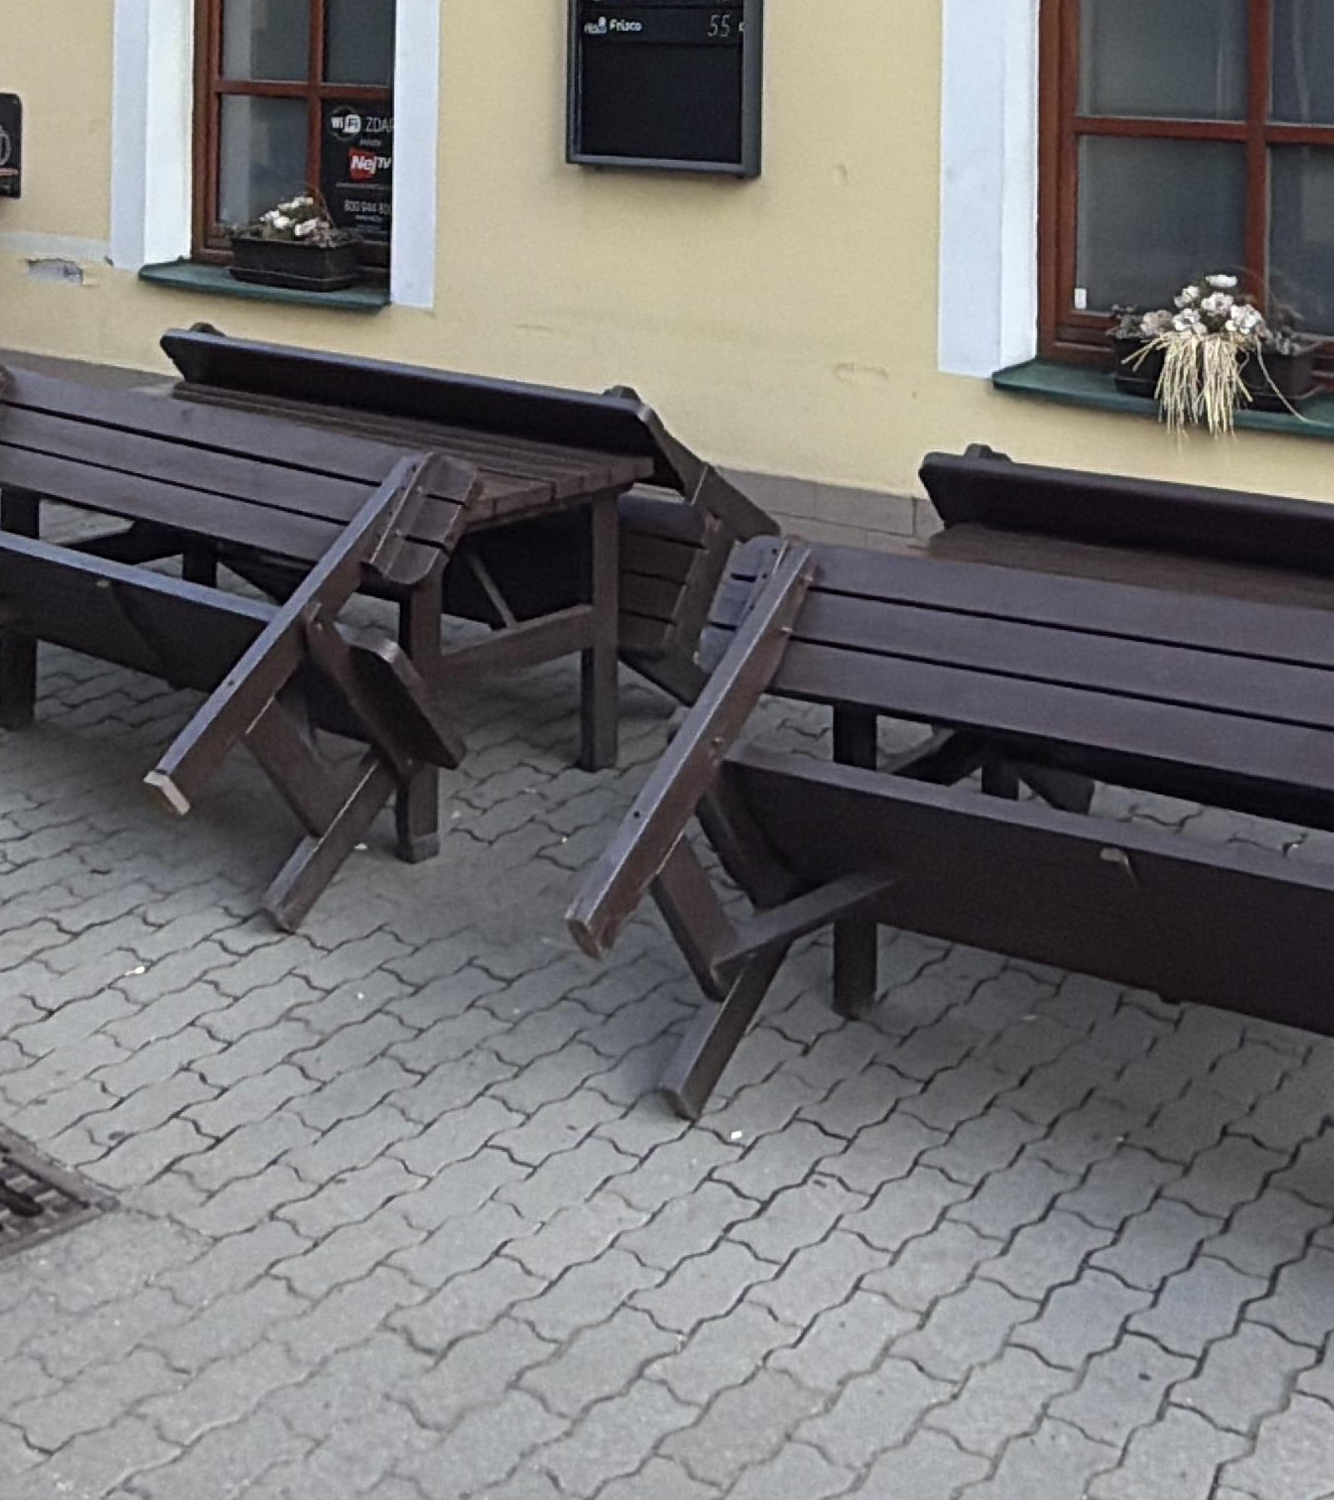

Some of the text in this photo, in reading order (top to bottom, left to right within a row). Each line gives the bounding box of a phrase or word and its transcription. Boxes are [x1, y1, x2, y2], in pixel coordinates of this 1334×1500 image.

[609, 18, 643, 33] Frisco
[707, 14, 732, 38] 55
[365, 115, 393, 133] ZDA
